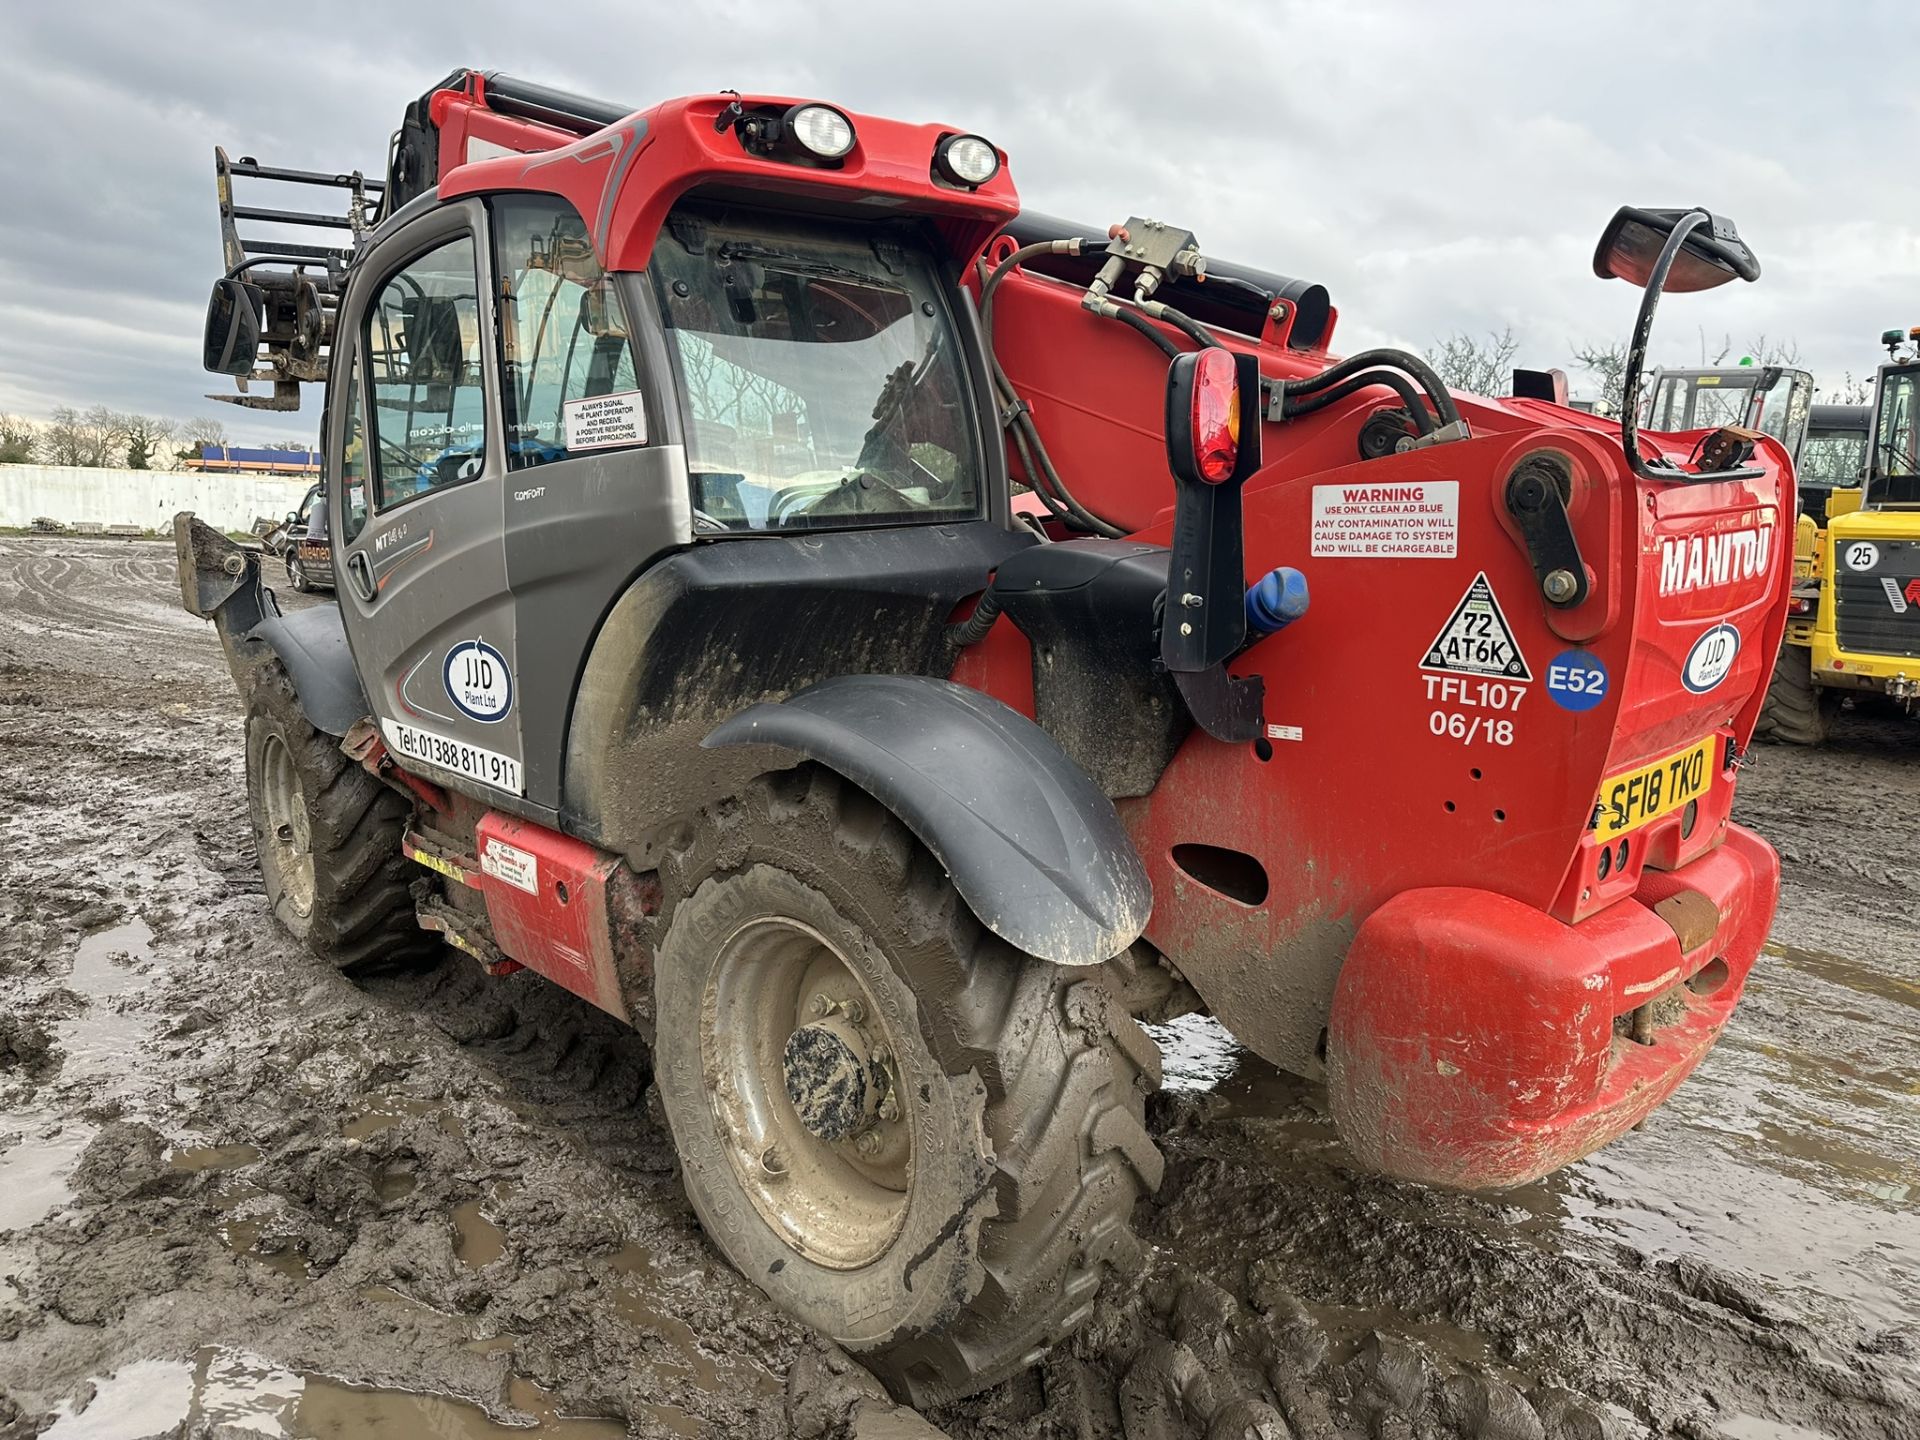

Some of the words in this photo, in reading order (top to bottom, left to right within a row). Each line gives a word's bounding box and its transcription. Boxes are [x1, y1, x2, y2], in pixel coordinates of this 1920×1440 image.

[574, 412, 585, 420] THE
[585, 410, 603, 419] PLANT
[603, 406, 633, 416] OPERATOR
[582, 401, 603, 411] ALWAYS
[603, 399, 624, 408] SIGNAL
[580, 427, 604, 436] POSITIVE
[604, 423, 634, 433] RESPONSE
[586, 419, 598, 427] AND
[598, 416, 622, 425] RECEIVE
[575, 435, 596, 445] BEFORE
[596, 431, 637, 442] APPROACHING
[513, 487, 546, 501] COMFORT
[1342, 487, 1424, 502] WARNING
[1325, 505, 1342, 514] USE
[1343, 504, 1367, 514] ONLY
[1369, 504, 1400, 513] CLEAN
[1403, 504, 1416, 513] AD
[1418, 503, 1443, 513] BLUE
[1314, 520, 1335, 528] ANY
[1337, 518, 1424, 528] CONTAMINATION
[1427, 518, 1454, 528] WILL
[1314, 532, 1346, 541] CAUSE
[1349, 532, 1393, 541] DAMAGE
[1395, 532, 1410, 541] TO
[1412, 532, 1454, 541] SYSTEM
[1314, 544, 1335, 553] AND
[1338, 544, 1363, 553] WILL
[1365, 544, 1378, 553] BE
[1381, 544, 1455, 554] CHARGEABLE
[1852, 547, 1872, 565] 25
[1659, 525, 1772, 597] MANITOU
[1463, 612, 1492, 638] 72
[1446, 636, 1506, 665] AT6K
[1702, 638, 1726, 667] JJD
[466, 657, 493, 689] JJD
[1548, 665, 1605, 695] E52
[1697, 666, 1713, 682] Plant
[465, 691, 483, 707] Plant
[484, 694, 497, 709] Ltd
[1421, 674, 1527, 712] TFL107
[1429, 710, 1514, 746] 06/18
[397, 725, 418, 754] Tel:
[419, 734, 459, 768] 01388
[461, 748, 486, 778] 811
[491, 757, 516, 788] 911
[1609, 768, 1663, 830] SF18
[1669, 748, 1704, 804] TKO
